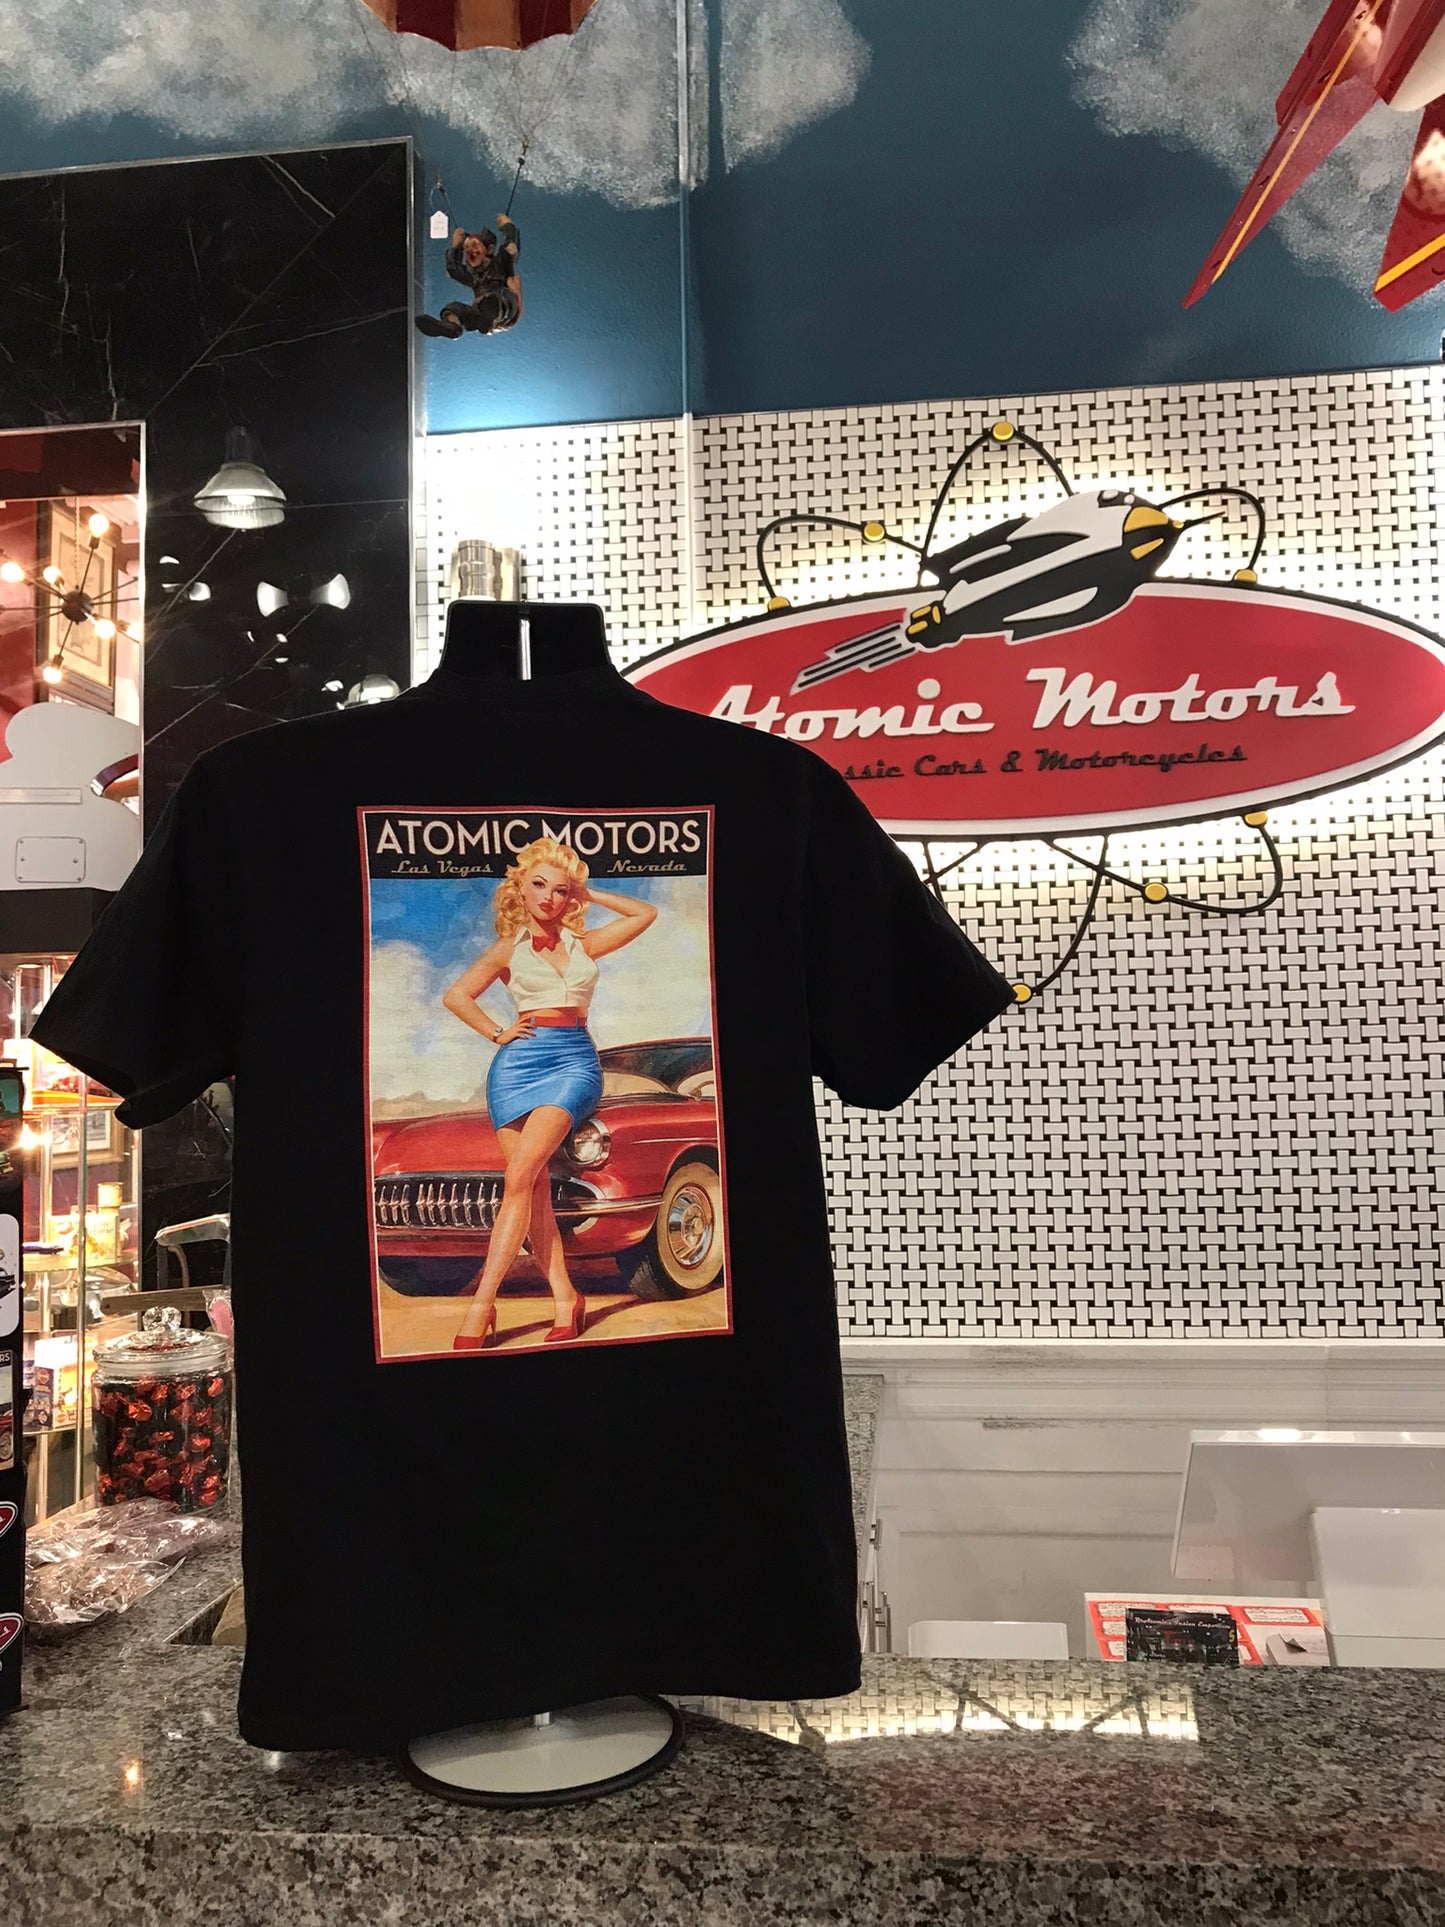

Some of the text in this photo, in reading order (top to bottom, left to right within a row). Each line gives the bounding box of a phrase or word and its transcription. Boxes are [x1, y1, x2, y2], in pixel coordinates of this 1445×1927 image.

[709, 667, 1356, 742] Atomic Motors
[913, 755, 987, 777] Cars
[1000, 750, 1024, 773] &
[1035, 744, 1248, 773] Motorcycles
[376, 818, 701, 856] ATOMIC MOTORS
[391, 859, 687, 878] Las Vegas Nevada
